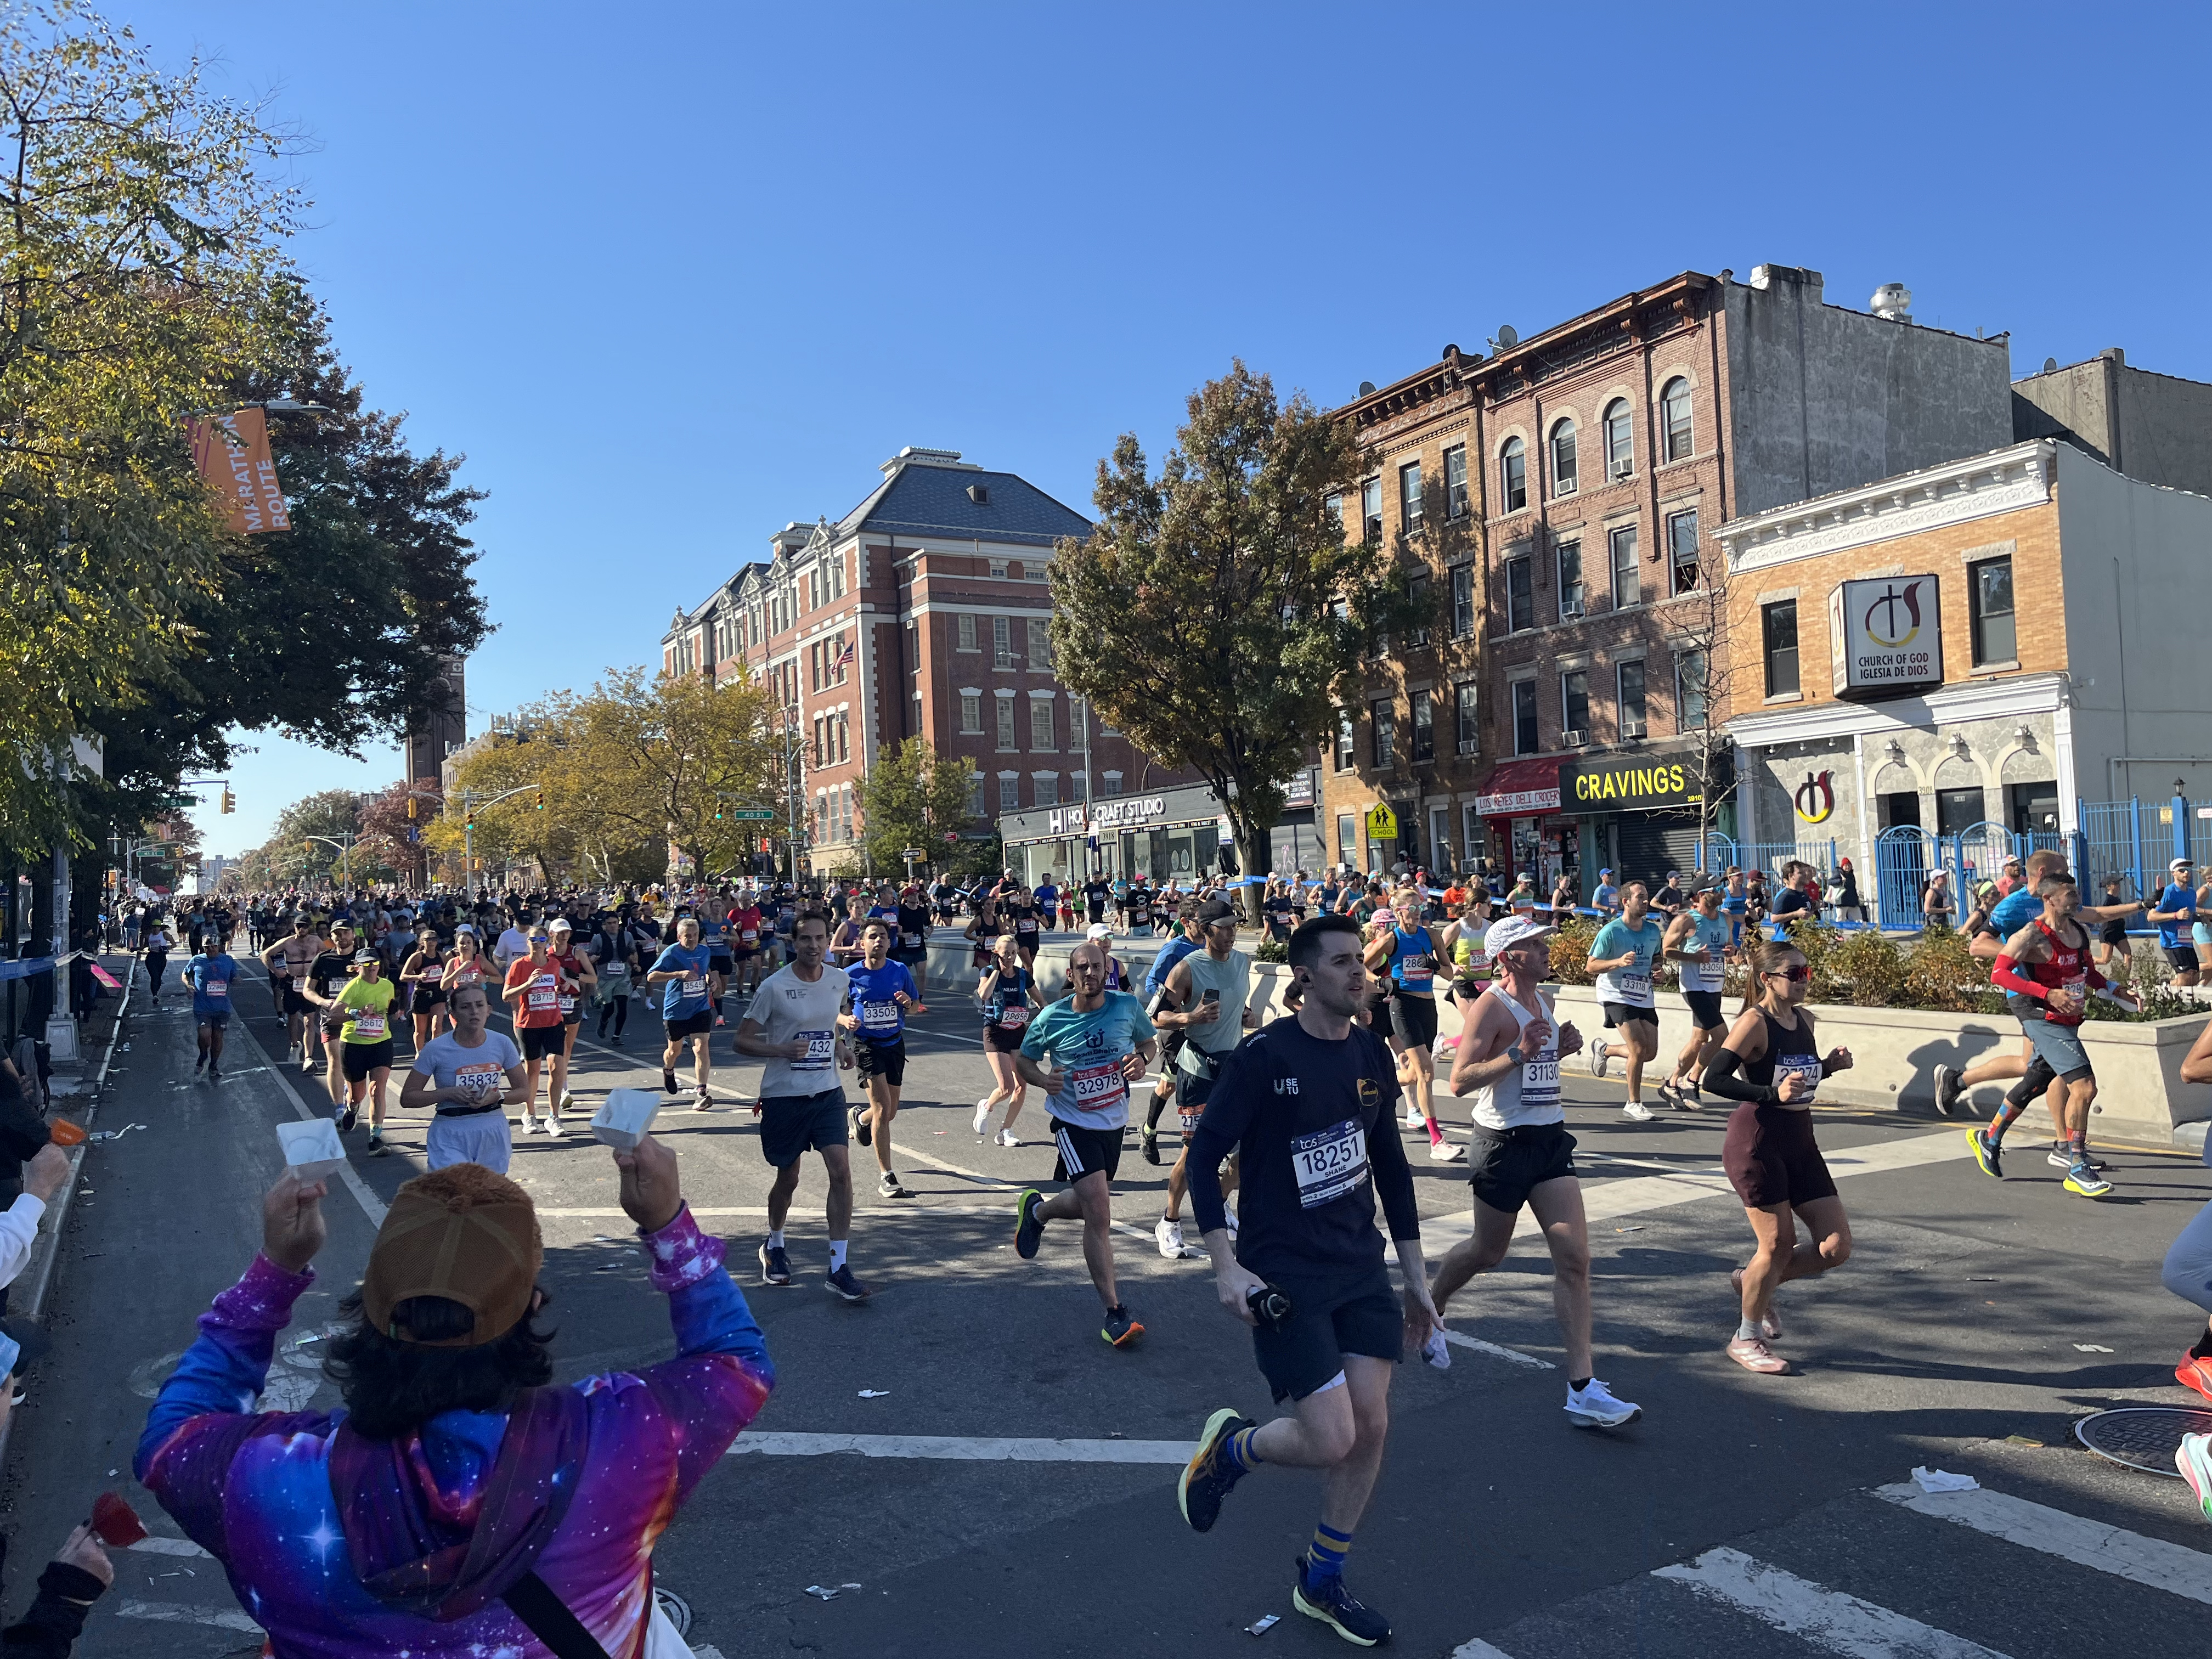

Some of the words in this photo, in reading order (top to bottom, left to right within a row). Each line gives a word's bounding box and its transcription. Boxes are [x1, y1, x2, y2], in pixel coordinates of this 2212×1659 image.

[256, 459, 288, 527] ROUTE
[1859, 655, 1893, 667] CHURCH
[1896, 653, 1906, 664] OF
[1910, 652, 1928, 663] GOD
[1860, 667, 1892, 679] IGLESIA
[1895, 667, 1905, 676] DE
[1908, 665, 1928, 676] DIOS
[1576, 765, 1685, 800] CRAVINGS
[1480, 797, 1491, 809] LOS
[1494, 795, 1513, 807] REYES
[1516, 793, 1532, 805] DELI
[1096, 803, 1125, 827] CRAFT
[1128, 798, 1164, 817] STUDIO
[1102, 831, 1114, 841] 3918
[1406, 958, 1421, 968] 286
[1701, 963, 1723, 972] 33056
[1624, 980, 1646, 991] 33118
[866, 1007, 896, 1018] 33505
[809, 1040, 831, 1053] 432
[1528, 1063, 1559, 1081] 31130
[459, 1072, 499, 1088] 35832
[1077, 1073, 1119, 1094] 32978
[1286, 1078, 1297, 1086] SE
[1286, 1086, 1299, 1095] TU
[1181, 1115, 1200, 1127] 275
[1300, 1138, 1317, 1150] tcs
[1302, 1135, 1359, 1175] 18251
[1324, 1164, 1347, 1177] SHANE
